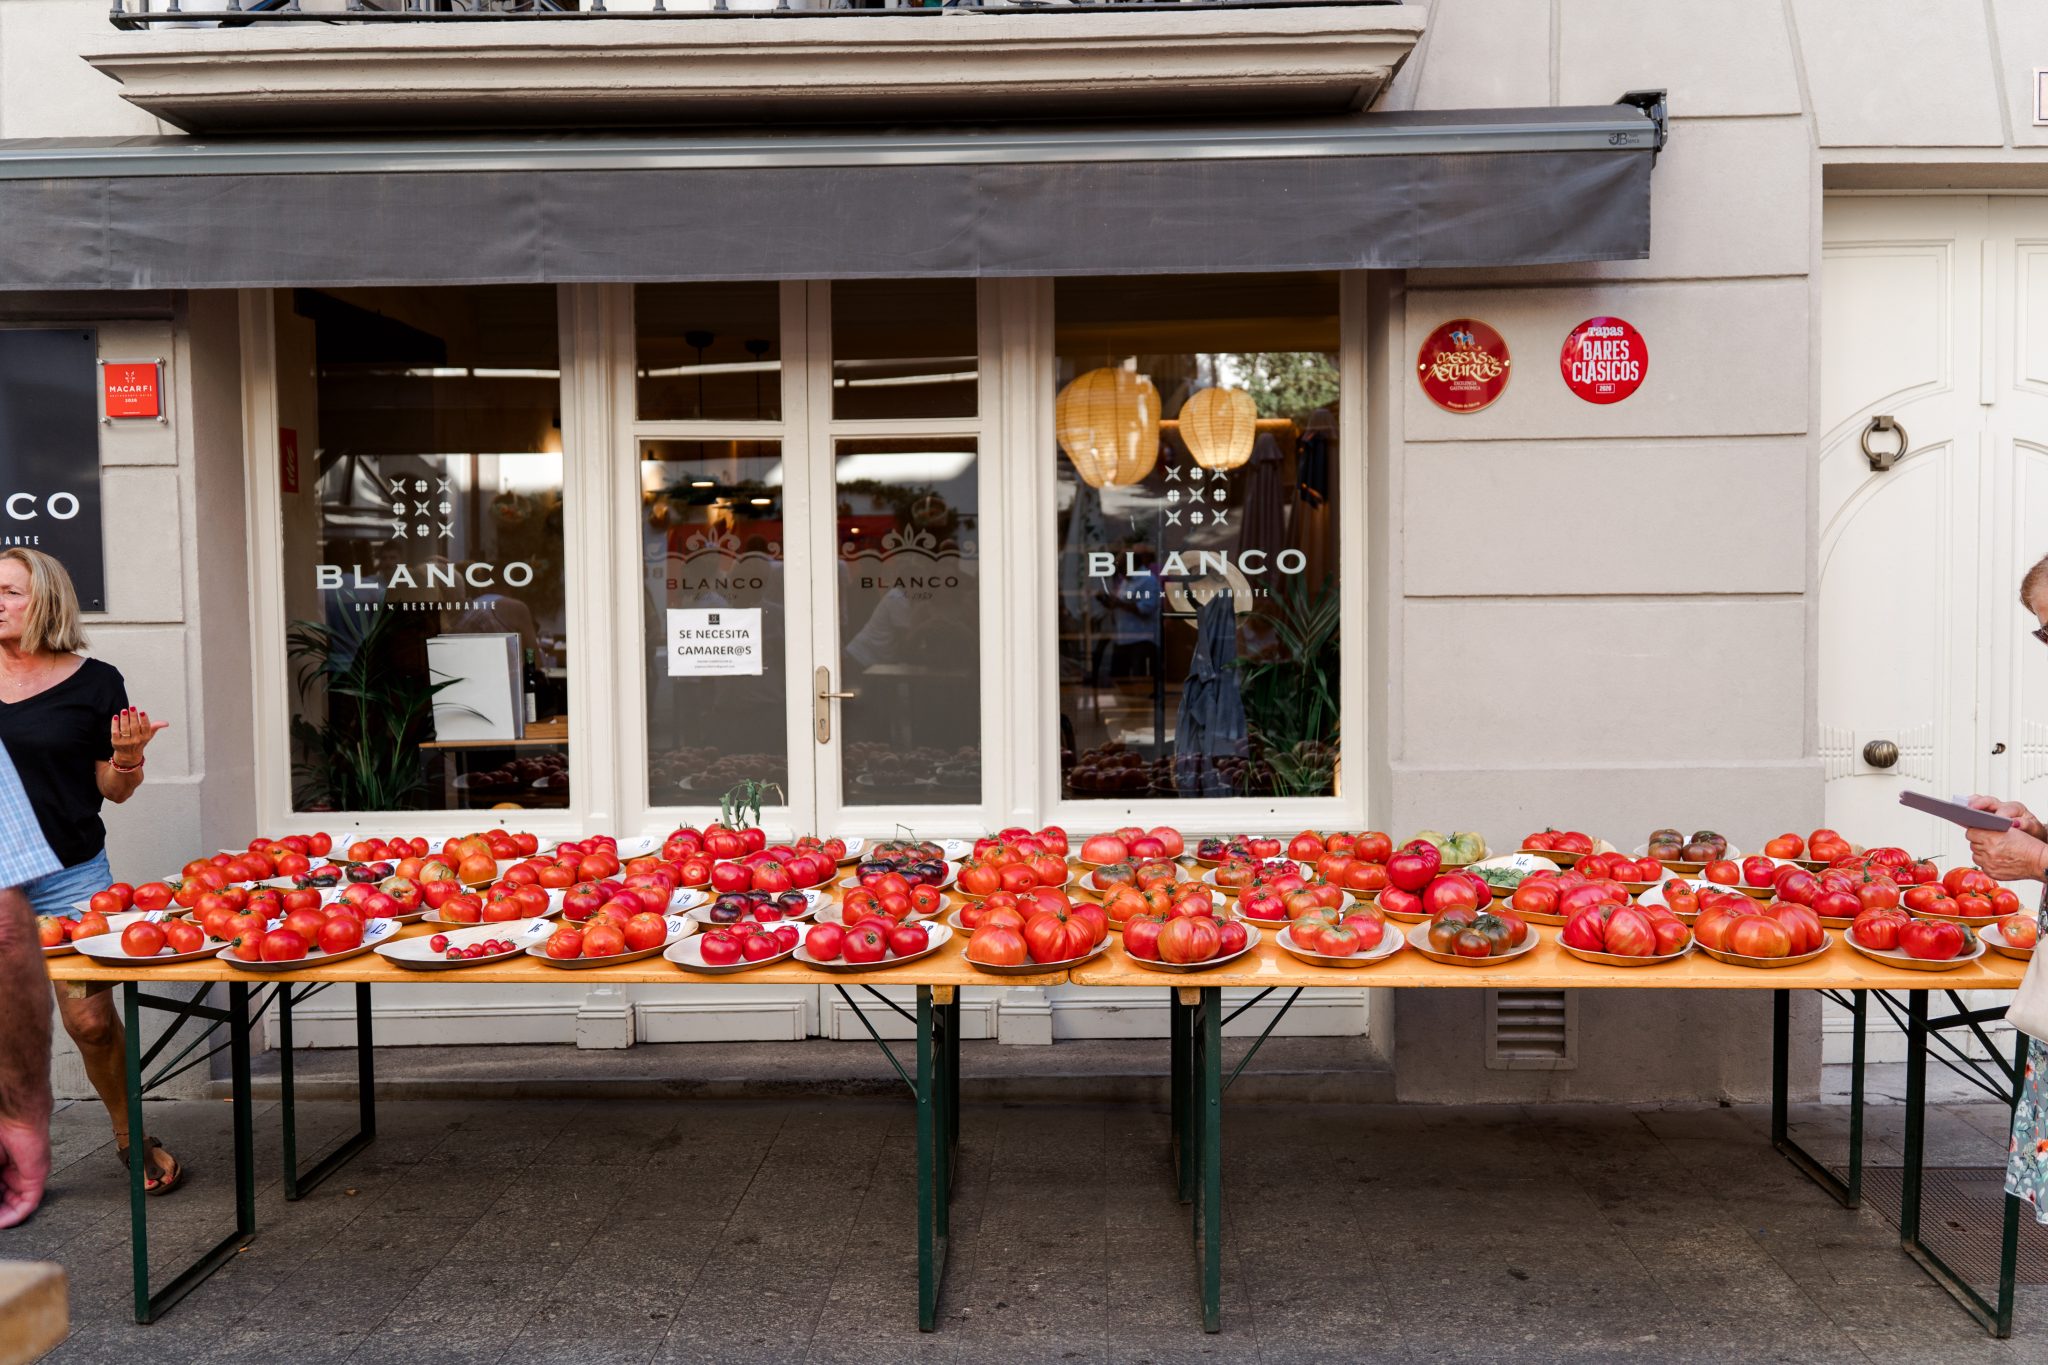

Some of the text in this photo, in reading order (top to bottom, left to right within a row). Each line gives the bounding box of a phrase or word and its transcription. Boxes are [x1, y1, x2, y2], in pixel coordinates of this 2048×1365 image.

[1583, 340, 1629, 361] BARES
[1572, 358, 1639, 384] CLÁSICOS
[109, 385, 152, 393] MACARFI
[0, 535, 40, 546] ANTE
[1088, 548, 1307, 577] BLANCO
[315, 561, 534, 590] BLANCO
[666, 577, 763, 590] BLANCO
[860, 576, 959, 589] BLANCO
[1126, 588, 1269, 600] BAR RESTAURANTE
[355, 601, 496, 612] BAR RESTAURANTE
[679, 629, 750, 639] SE NECESITA
[677, 645, 752, 656] CAMARER@S
[947, 841, 960, 850] 25
[676, 893, 692, 905] 19
[369, 922, 388, 935] 12
[667, 920, 682, 933] 20
